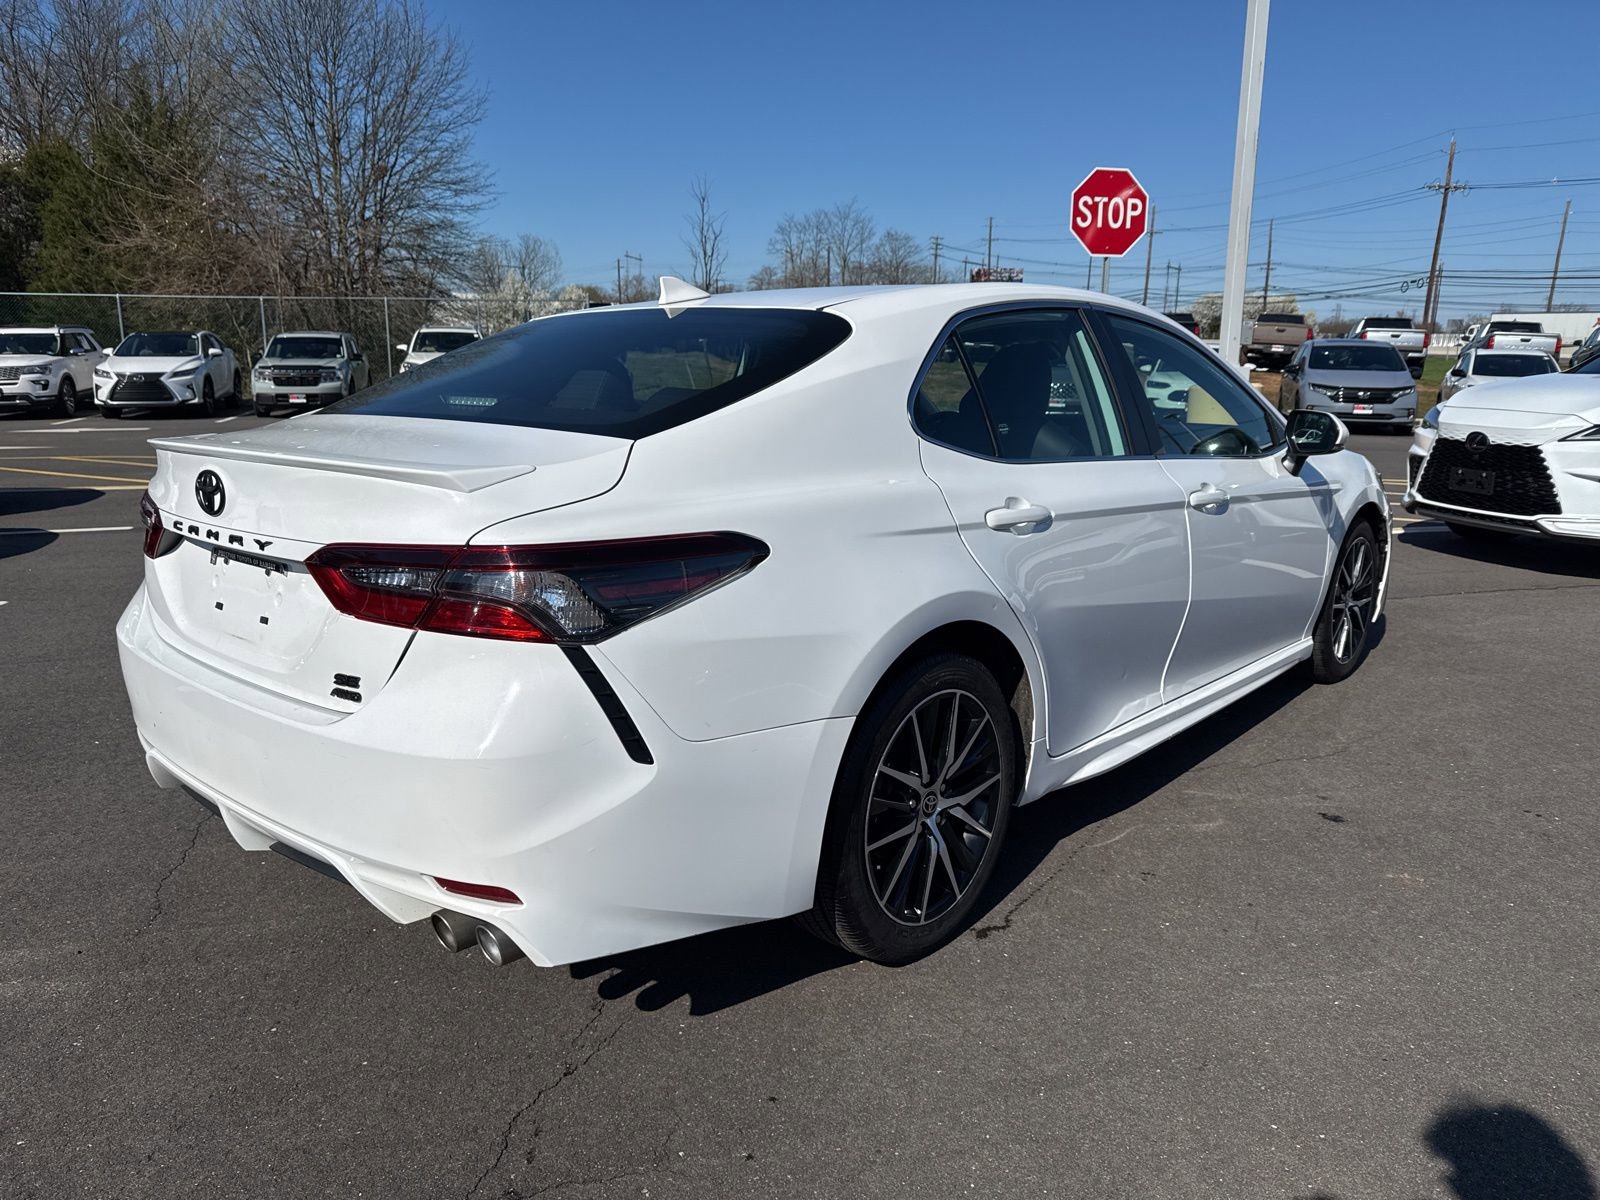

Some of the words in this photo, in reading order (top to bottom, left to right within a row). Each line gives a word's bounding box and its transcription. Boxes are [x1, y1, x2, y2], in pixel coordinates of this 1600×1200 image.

[1076, 195, 1143, 229] STOP
[173, 520, 273, 551] CAMRY
[333, 673, 361, 689] SE
